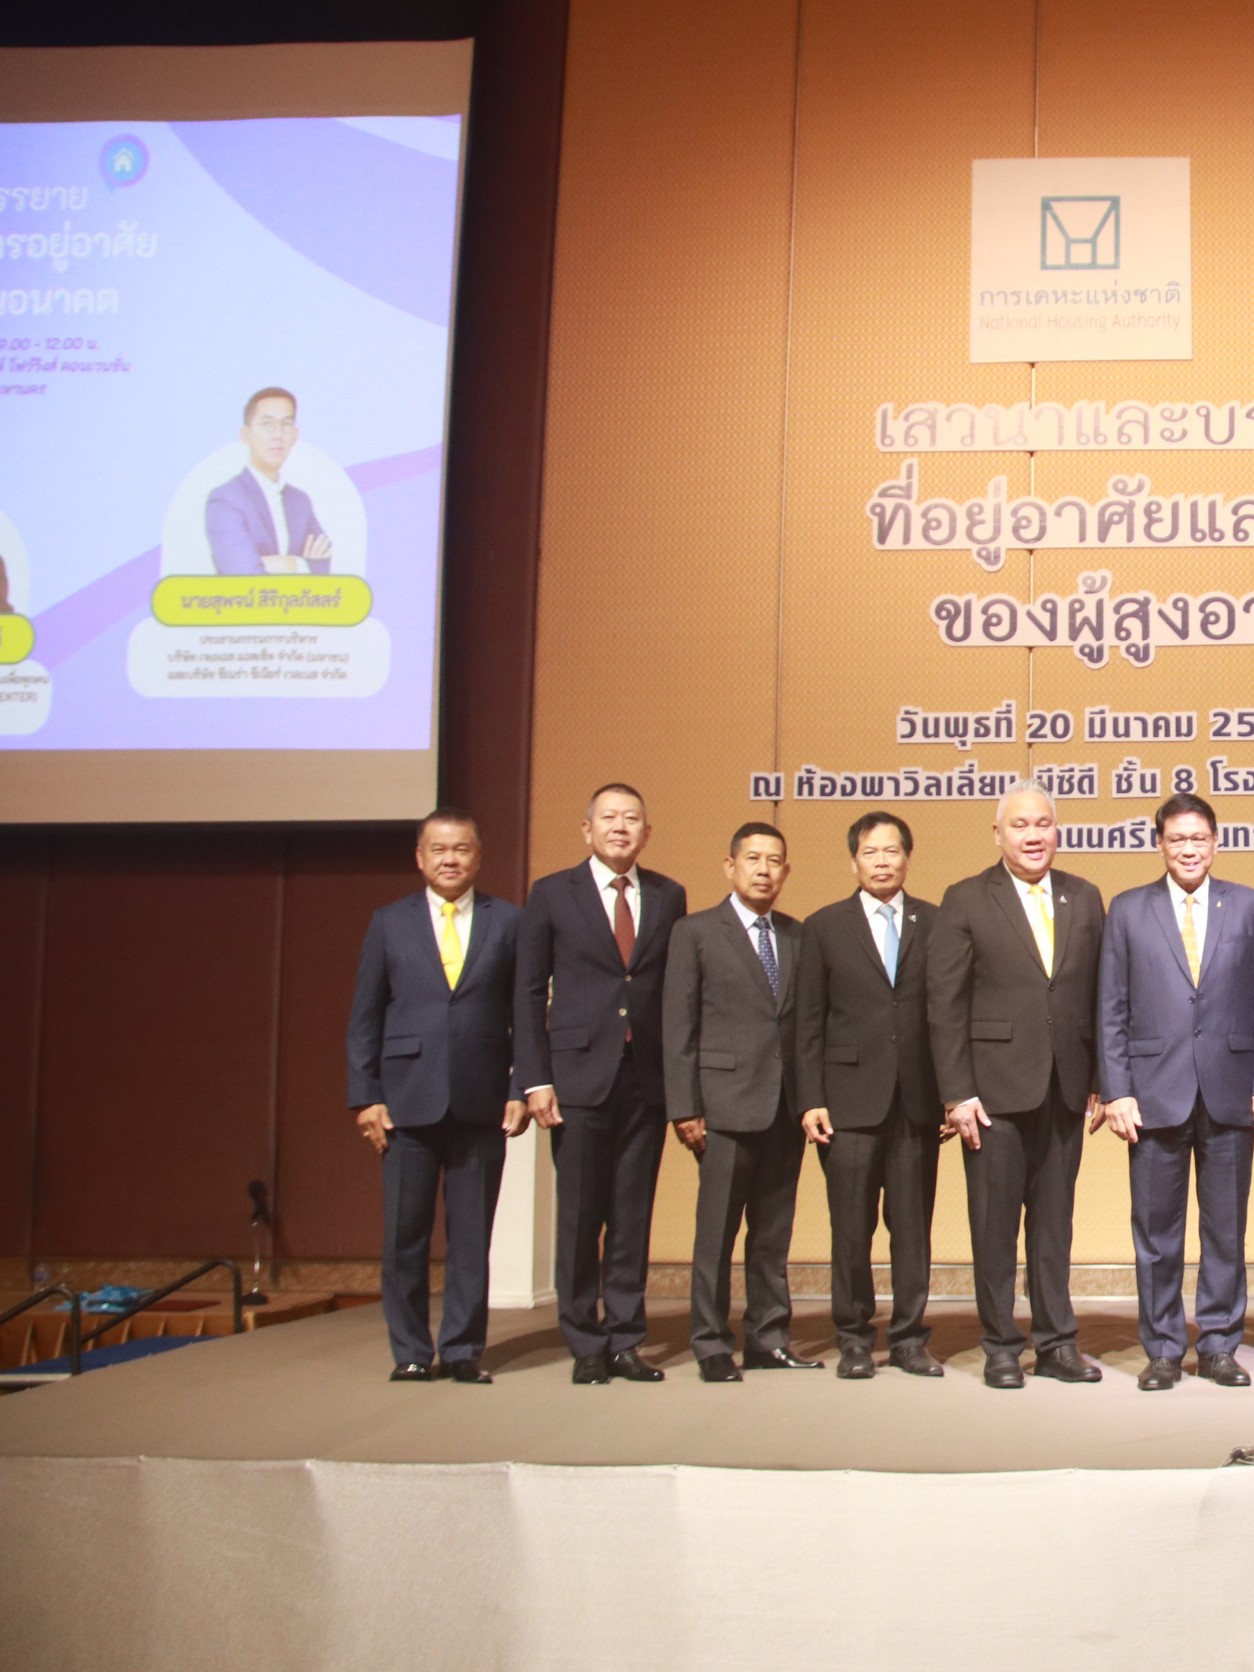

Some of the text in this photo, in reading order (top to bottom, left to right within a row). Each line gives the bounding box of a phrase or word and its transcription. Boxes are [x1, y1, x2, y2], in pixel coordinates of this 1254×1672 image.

[0, 219, 159, 273] รอยู่อาศัย
[979, 279, 1181, 307] การเคหะแห่งชาติ
[980, 312, 1181, 333] National Housing Authority
[902, 703, 1013, 747] วันพุธที่
[1029, 713, 1070, 739] 20
[1088, 711, 1194, 739] มีนาคม
[754, 776, 781, 797] ณ
[1116, 759, 1157, 794] ชั้น
[1174, 768, 1194, 794] 8
